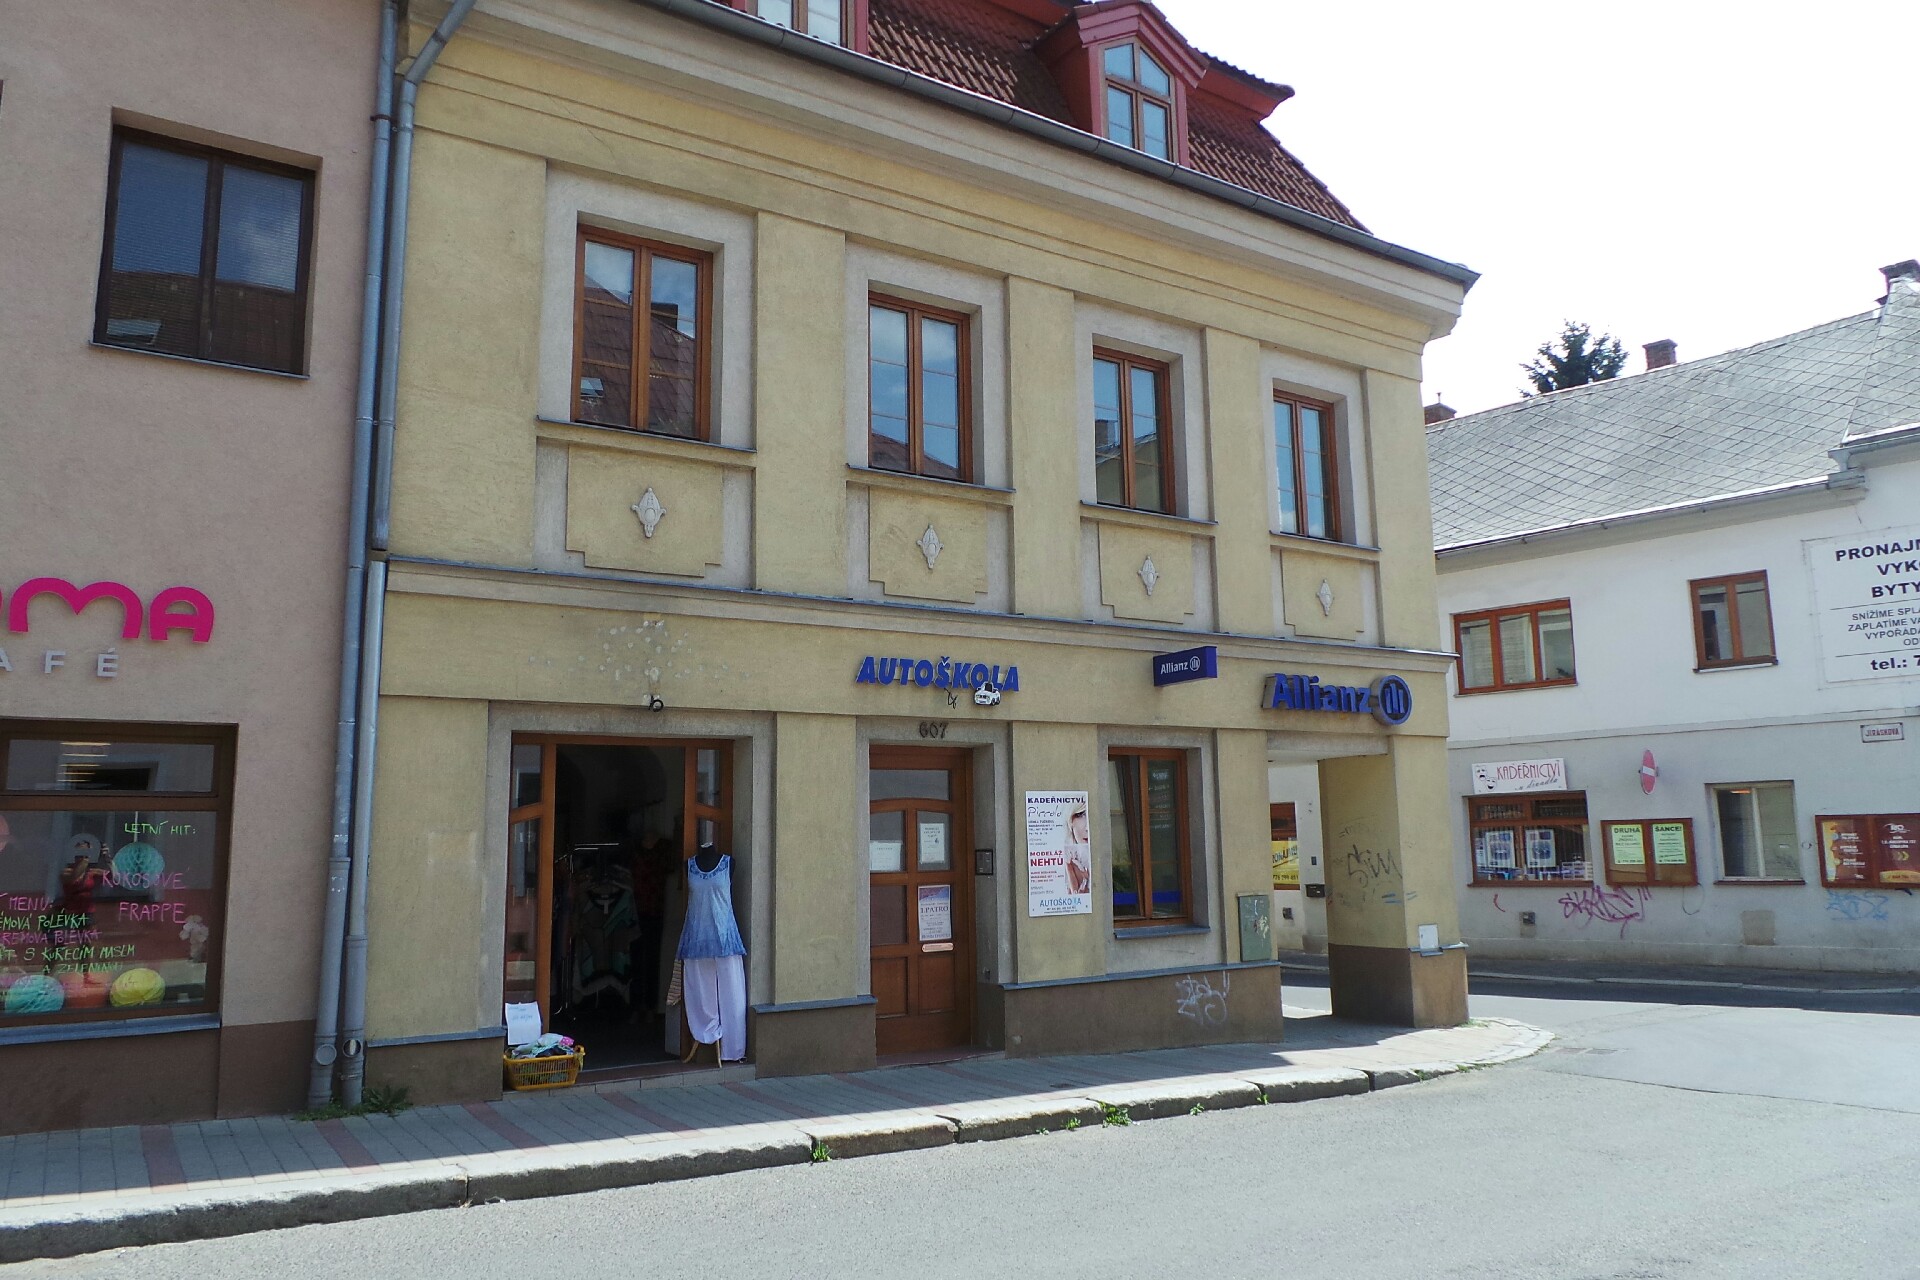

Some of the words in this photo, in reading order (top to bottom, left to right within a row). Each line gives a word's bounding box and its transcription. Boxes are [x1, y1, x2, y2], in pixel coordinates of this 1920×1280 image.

[0, 577, 215, 643] MA
[1852, 609, 1895, 621] SNÍŽÍME
[1848, 618, 1908, 632] ZAPLATÍME
[1903, 638, 1920, 646] OD
[1160, 660, 1189, 675] Allianz
[1870, 657, 1907, 671] tel.:
[856, 655, 1020, 692] AUTOŠKOLA
[1270, 672, 1373, 714] Allianz
[1496, 760, 1561, 781] KADEŘNICTVÍ
[124, 820, 168, 835] LETNÍ
